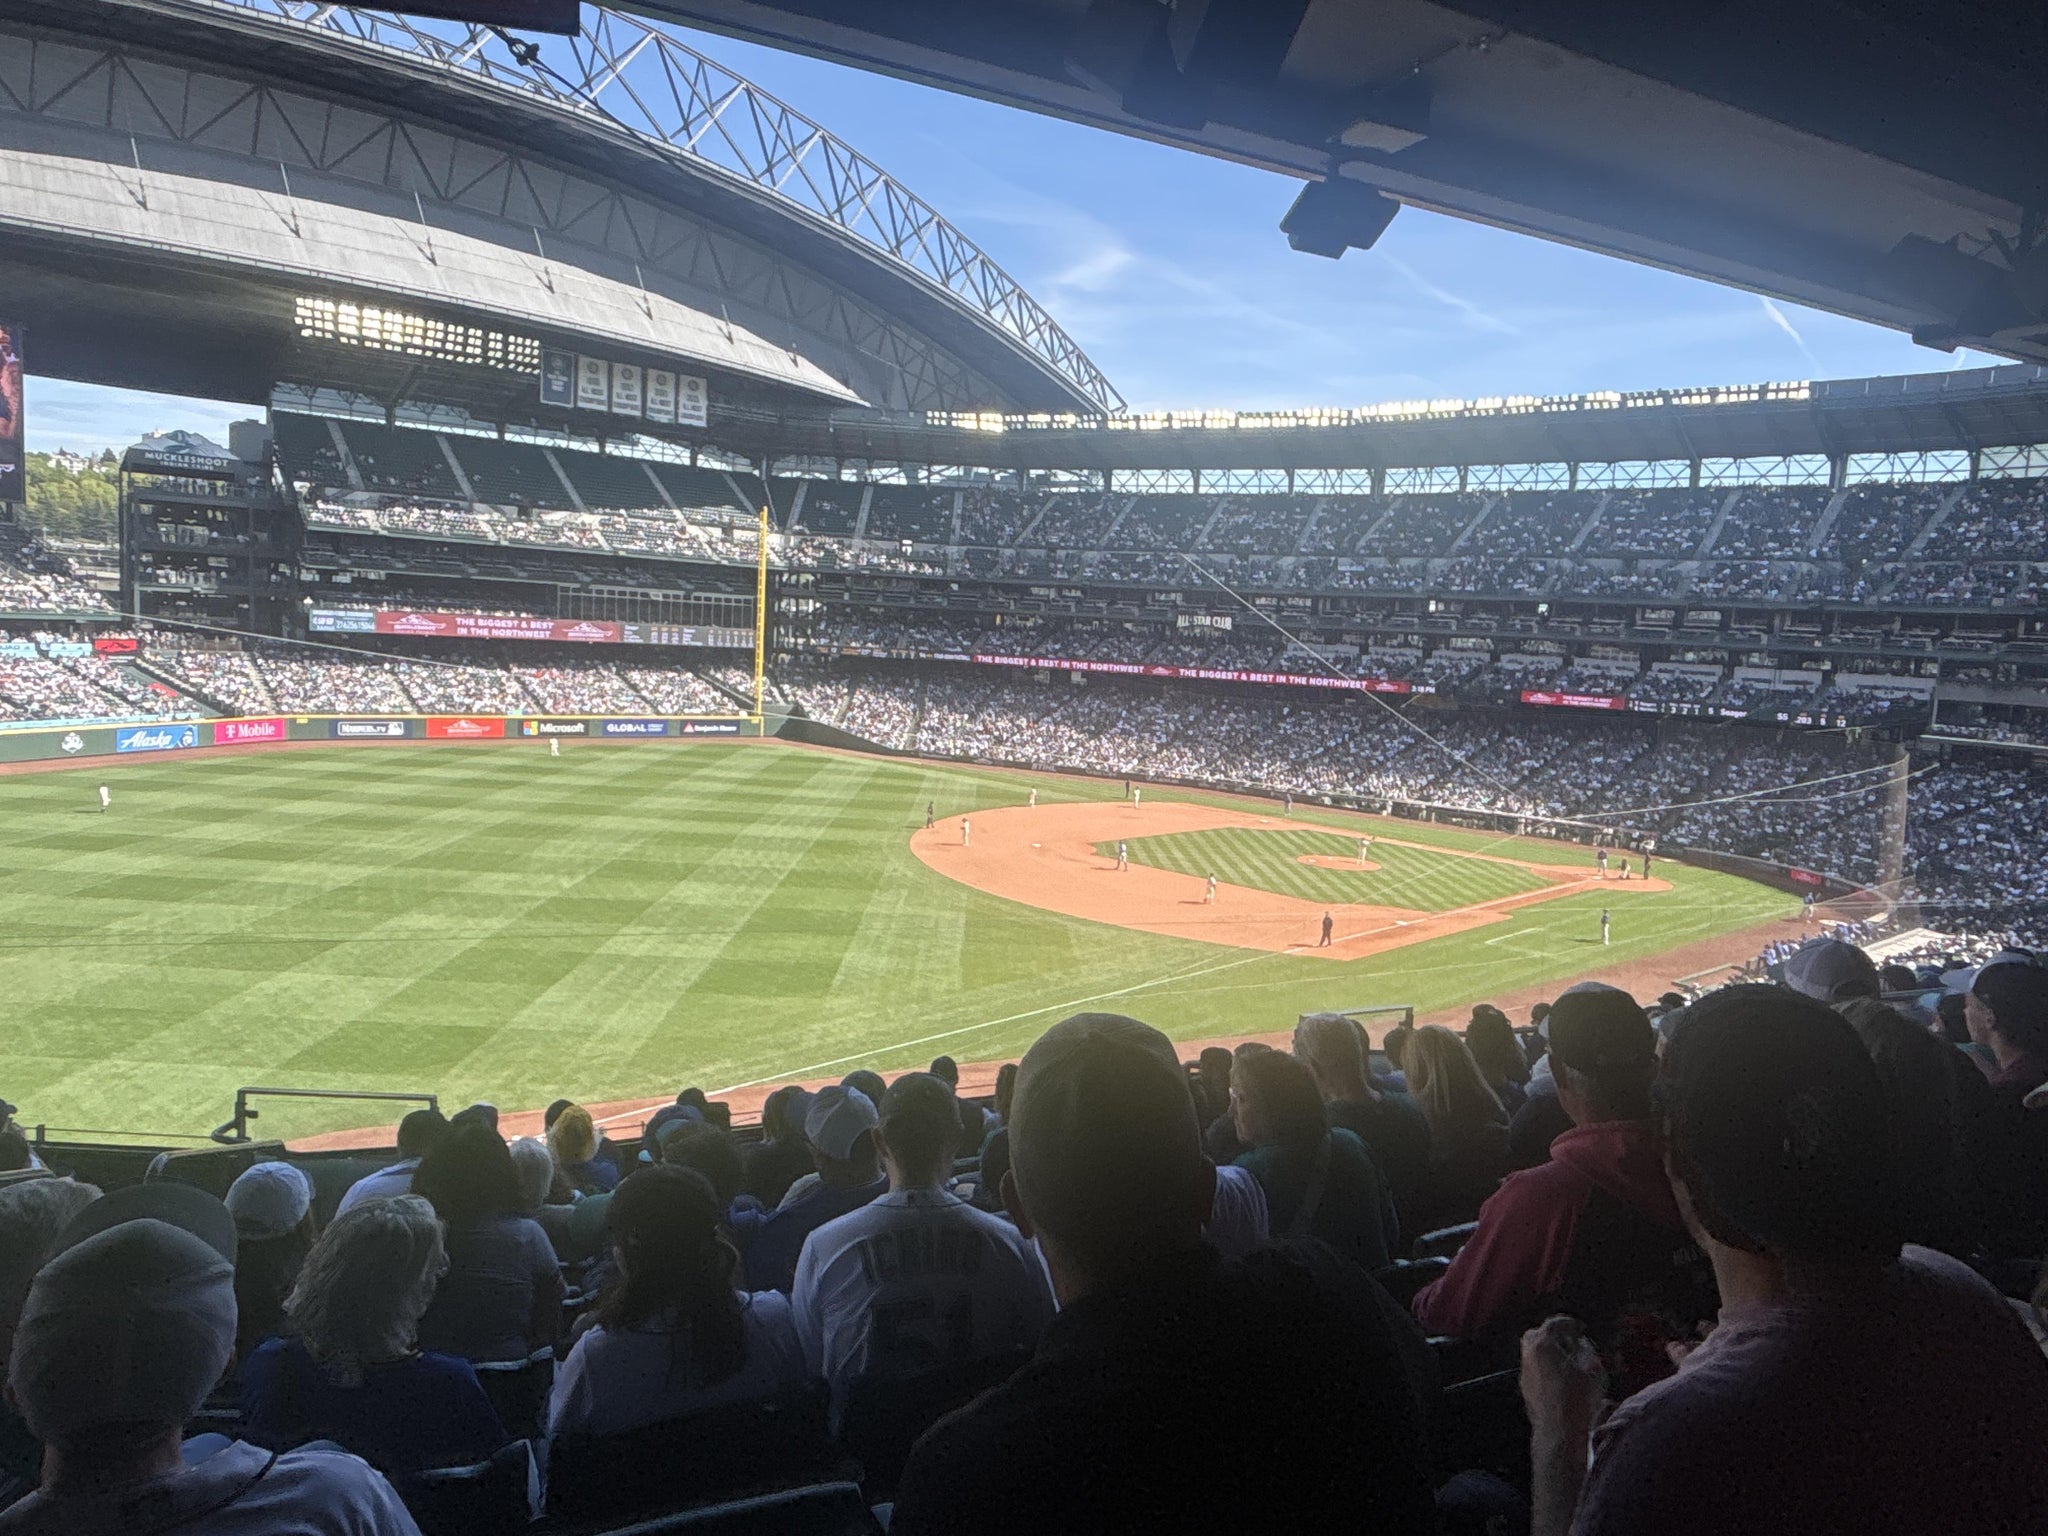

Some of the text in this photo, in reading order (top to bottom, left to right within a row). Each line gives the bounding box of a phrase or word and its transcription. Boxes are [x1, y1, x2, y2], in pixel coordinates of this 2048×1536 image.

[144, 451, 229, 467] MUCKLESHOOT
[455, 617, 475, 626] THE
[478, 619, 519, 628] BIGGEST
[530, 621, 555, 629] BEST
[1212, 616, 1232, 630] CLUB
[457, 627, 551, 638] IN THE NORTHWEST
[977, 655, 993, 663] THE
[995, 657, 1029, 666] BIGGEST
[1038, 659, 1059, 667] BEST
[1071, 661, 1088, 670] THE
[1090, 662, 1145, 674] NORTHWEST
[1179, 668, 1368, 689] THE BIGGEST & BEST IN THE NORTHWEST
[1670, 706, 1677, 714] 3
[1682, 707, 1688, 715] 2
[1720, 708, 1747, 719] Seager
[1777, 712, 1789, 721] SS
[1836, 719, 1847, 728] 12
[238, 722, 275, 738] Mobile
[540, 722, 585, 733] Microsoft
[606, 723, 647, 732] GLOBAL
[120, 730, 172, 748] Alaska
